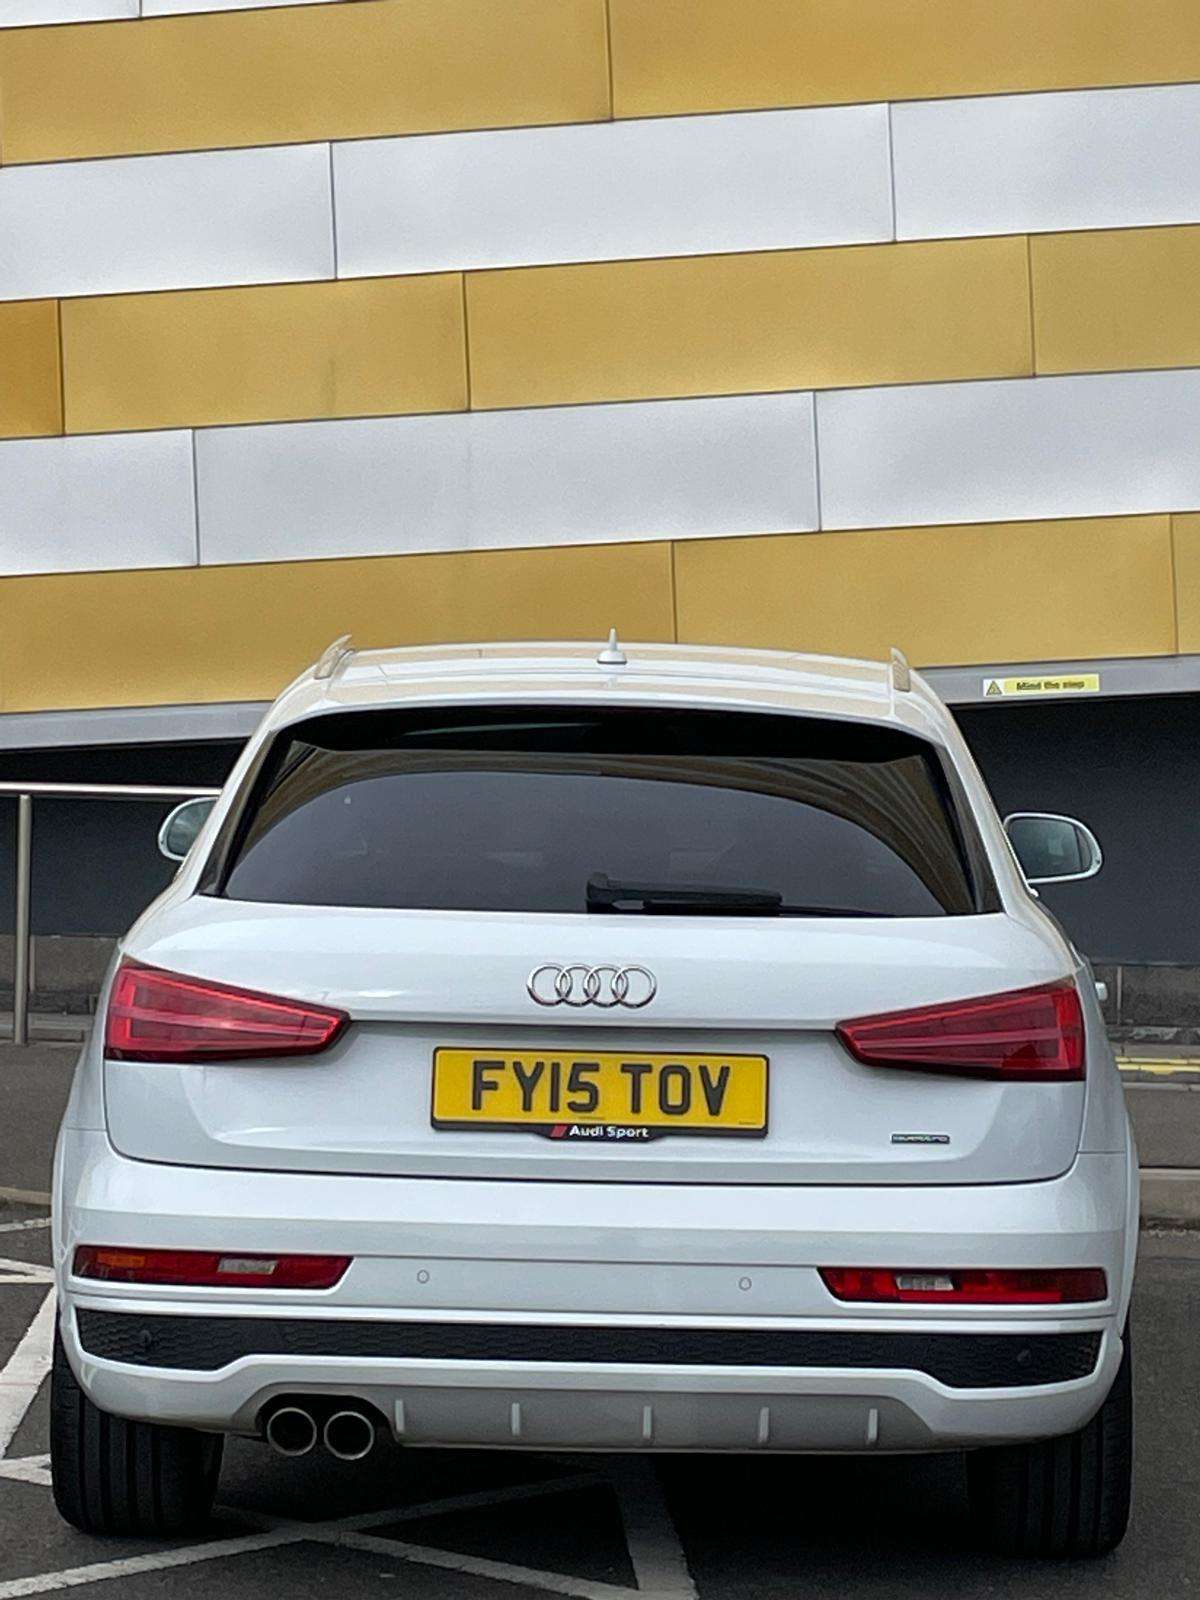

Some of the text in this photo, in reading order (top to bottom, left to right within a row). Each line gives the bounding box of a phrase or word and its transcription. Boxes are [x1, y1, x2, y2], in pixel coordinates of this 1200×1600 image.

[472, 1060, 730, 1116] FY15 TOV
[569, 1125, 649, 1138] Audi Sport
